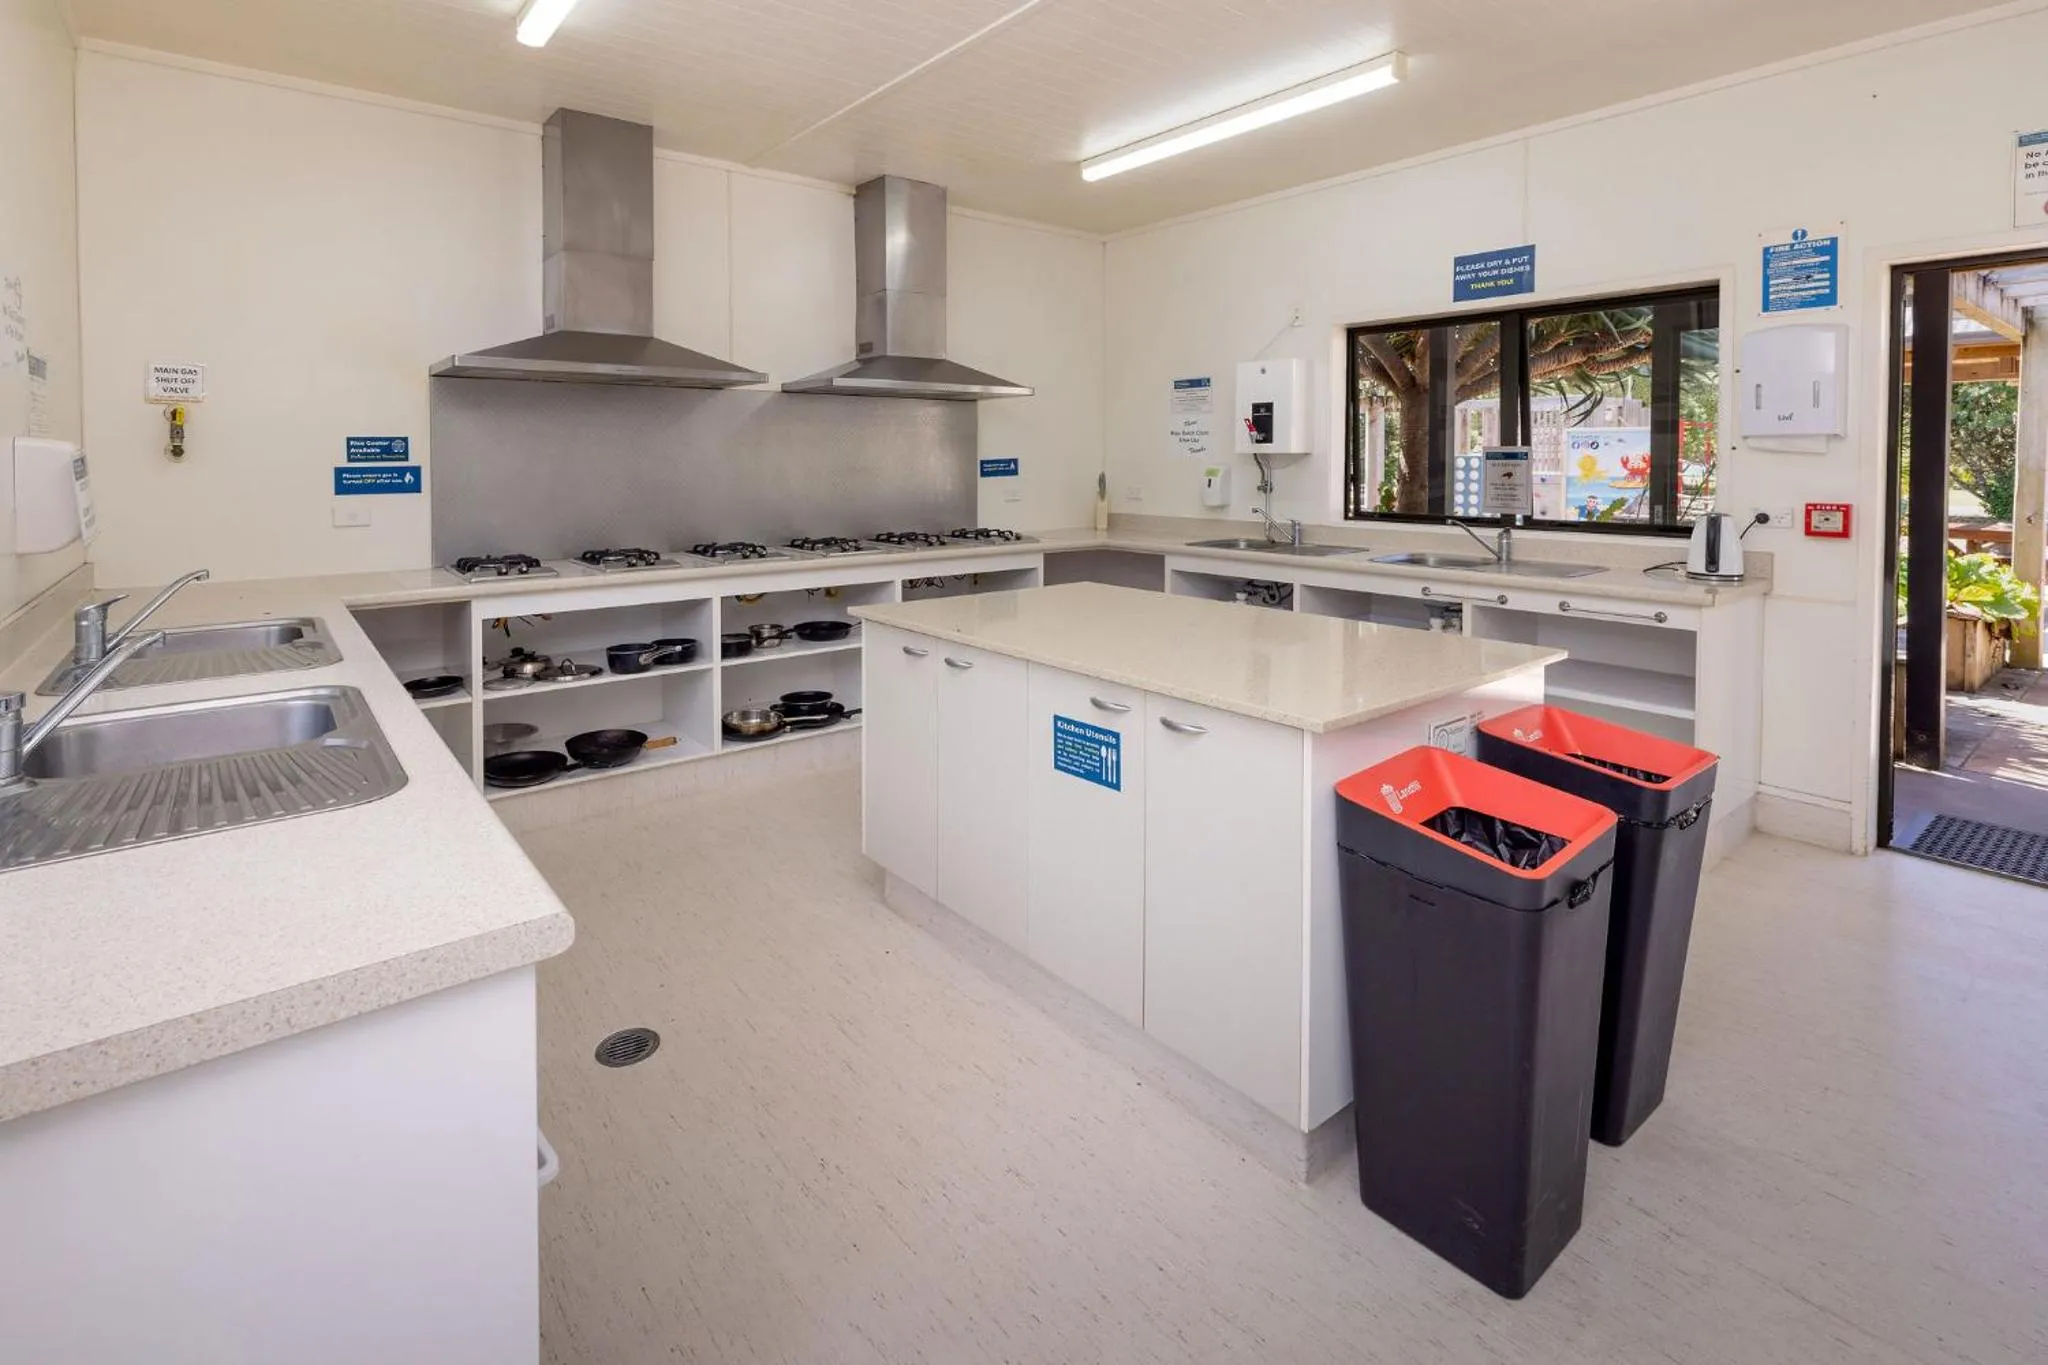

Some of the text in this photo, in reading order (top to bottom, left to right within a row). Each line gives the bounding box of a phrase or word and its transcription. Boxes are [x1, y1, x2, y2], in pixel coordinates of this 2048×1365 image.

[2025, 151, 2041, 159] No
[1793, 239, 1830, 249] ACTION
[1456, 262, 1485, 272] PLEASE
[1487, 260, 1502, 268] DRY
[1512, 256, 1529, 264] PUT
[1455, 264, 1530, 281] AWAY YOUR DISHES
[1470, 281, 1495, 290] THANK
[153, 366, 178, 374] MAIN
[155, 376, 196, 385] SHUT OFF
[1057, 720, 1117, 745] Kitchen Utensils
